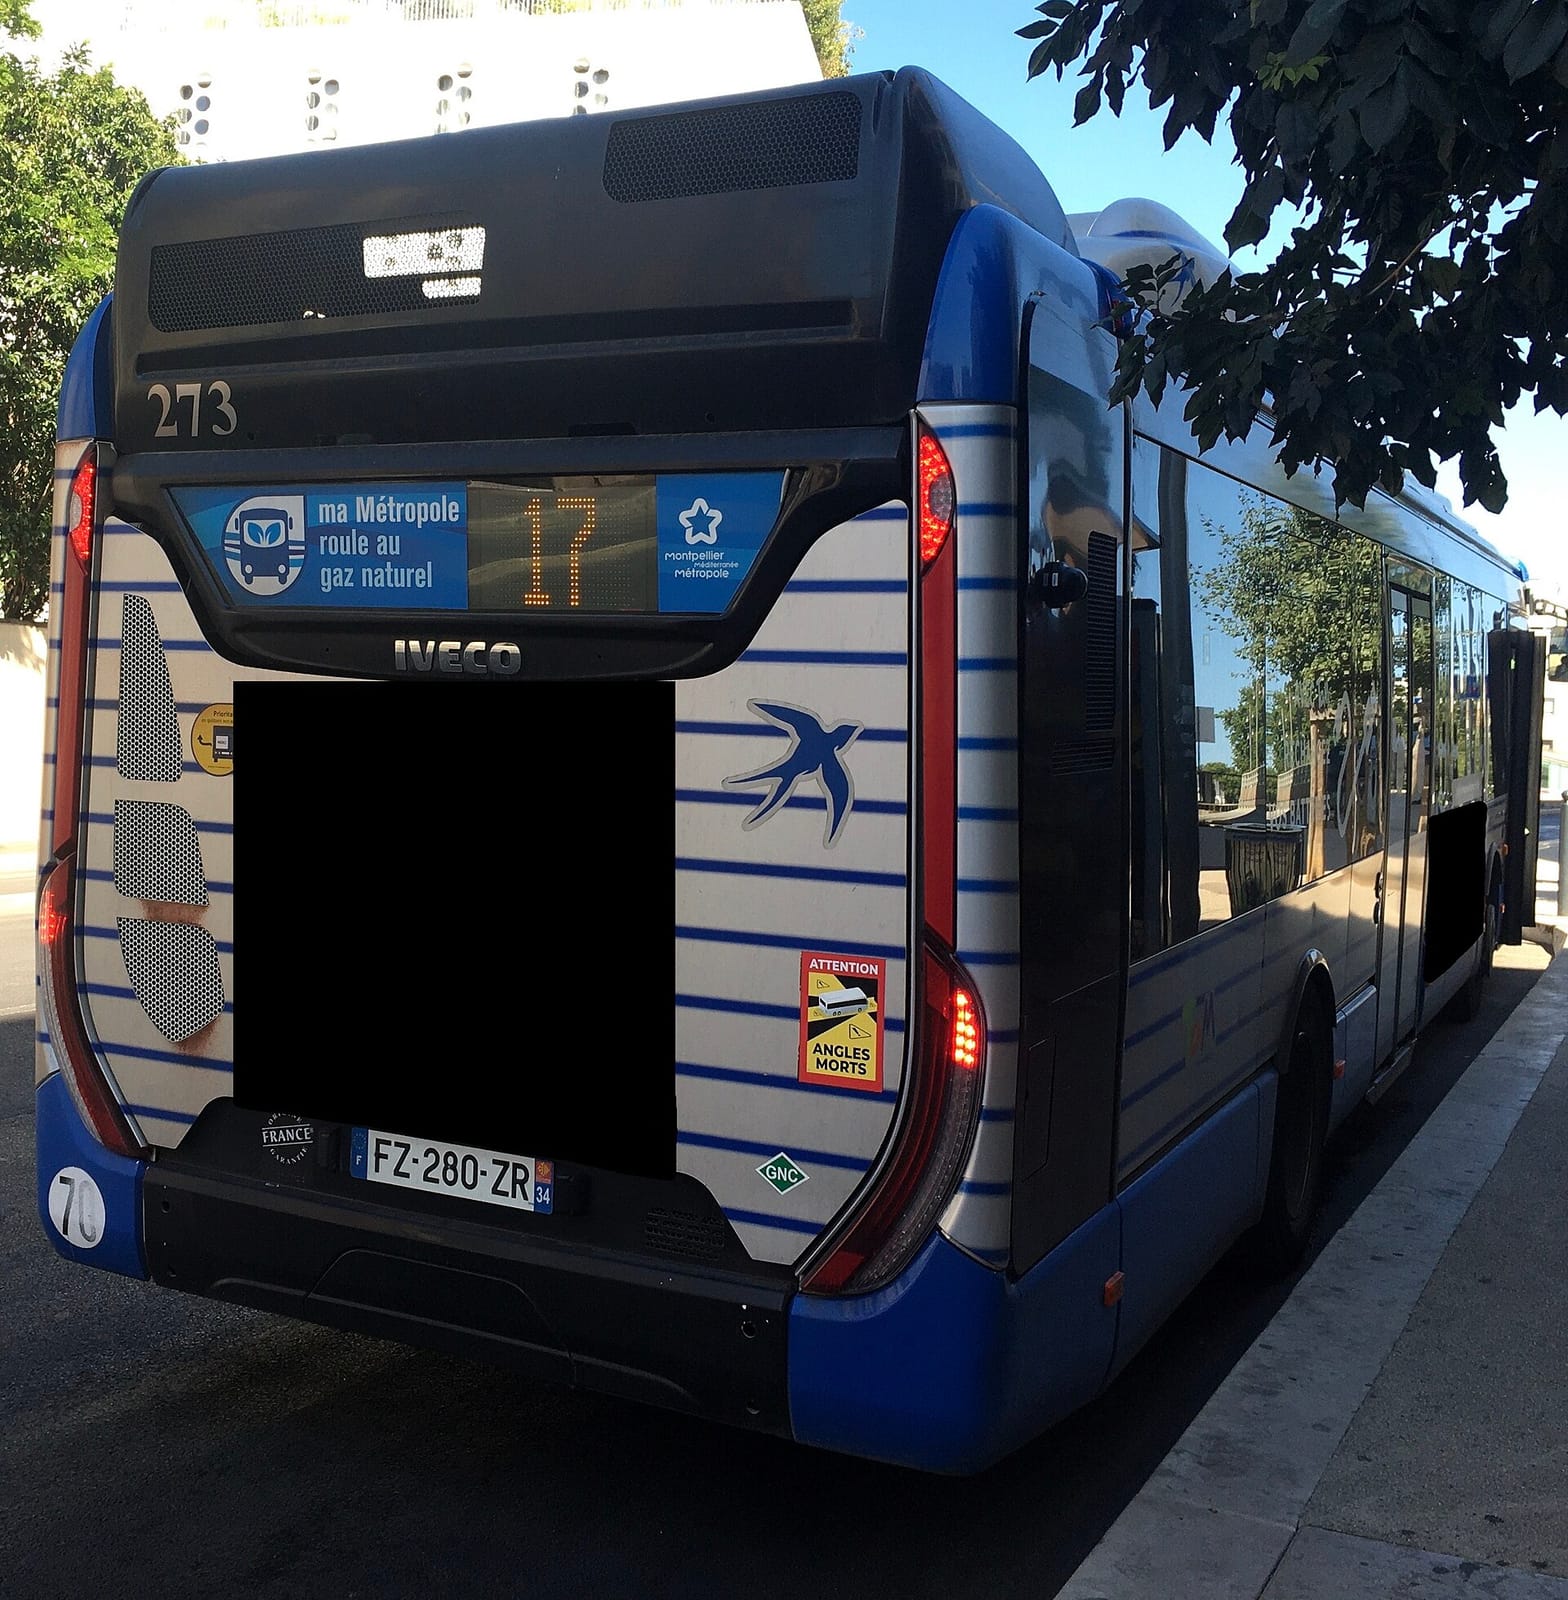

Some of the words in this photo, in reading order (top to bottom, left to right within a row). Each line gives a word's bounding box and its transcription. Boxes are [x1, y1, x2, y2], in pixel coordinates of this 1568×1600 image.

[147, 380, 238, 437] 273
[319, 502, 348, 523] ma
[356, 495, 460, 529] Métropole
[319, 529, 369, 555] roule
[377, 533, 400, 555] au
[524, 498, 596, 606] 17
[320, 565, 354, 592] gaz
[362, 561, 433, 588] naturel
[394, 639, 522, 675] IVECO
[1289, 794, 1332, 826] BATTES
[809, 958, 879, 975] ATTENTION
[813, 1043, 870, 1061] ANGLES
[816, 1058, 867, 1075] MORTS
[262, 1127, 311, 1144] FRANCE
[356, 1155, 362, 1165] F
[375, 1137, 530, 1202] FZ-280-ZR
[536, 1186, 550, 1204] 34
[765, 1165, 799, 1183] GNC
